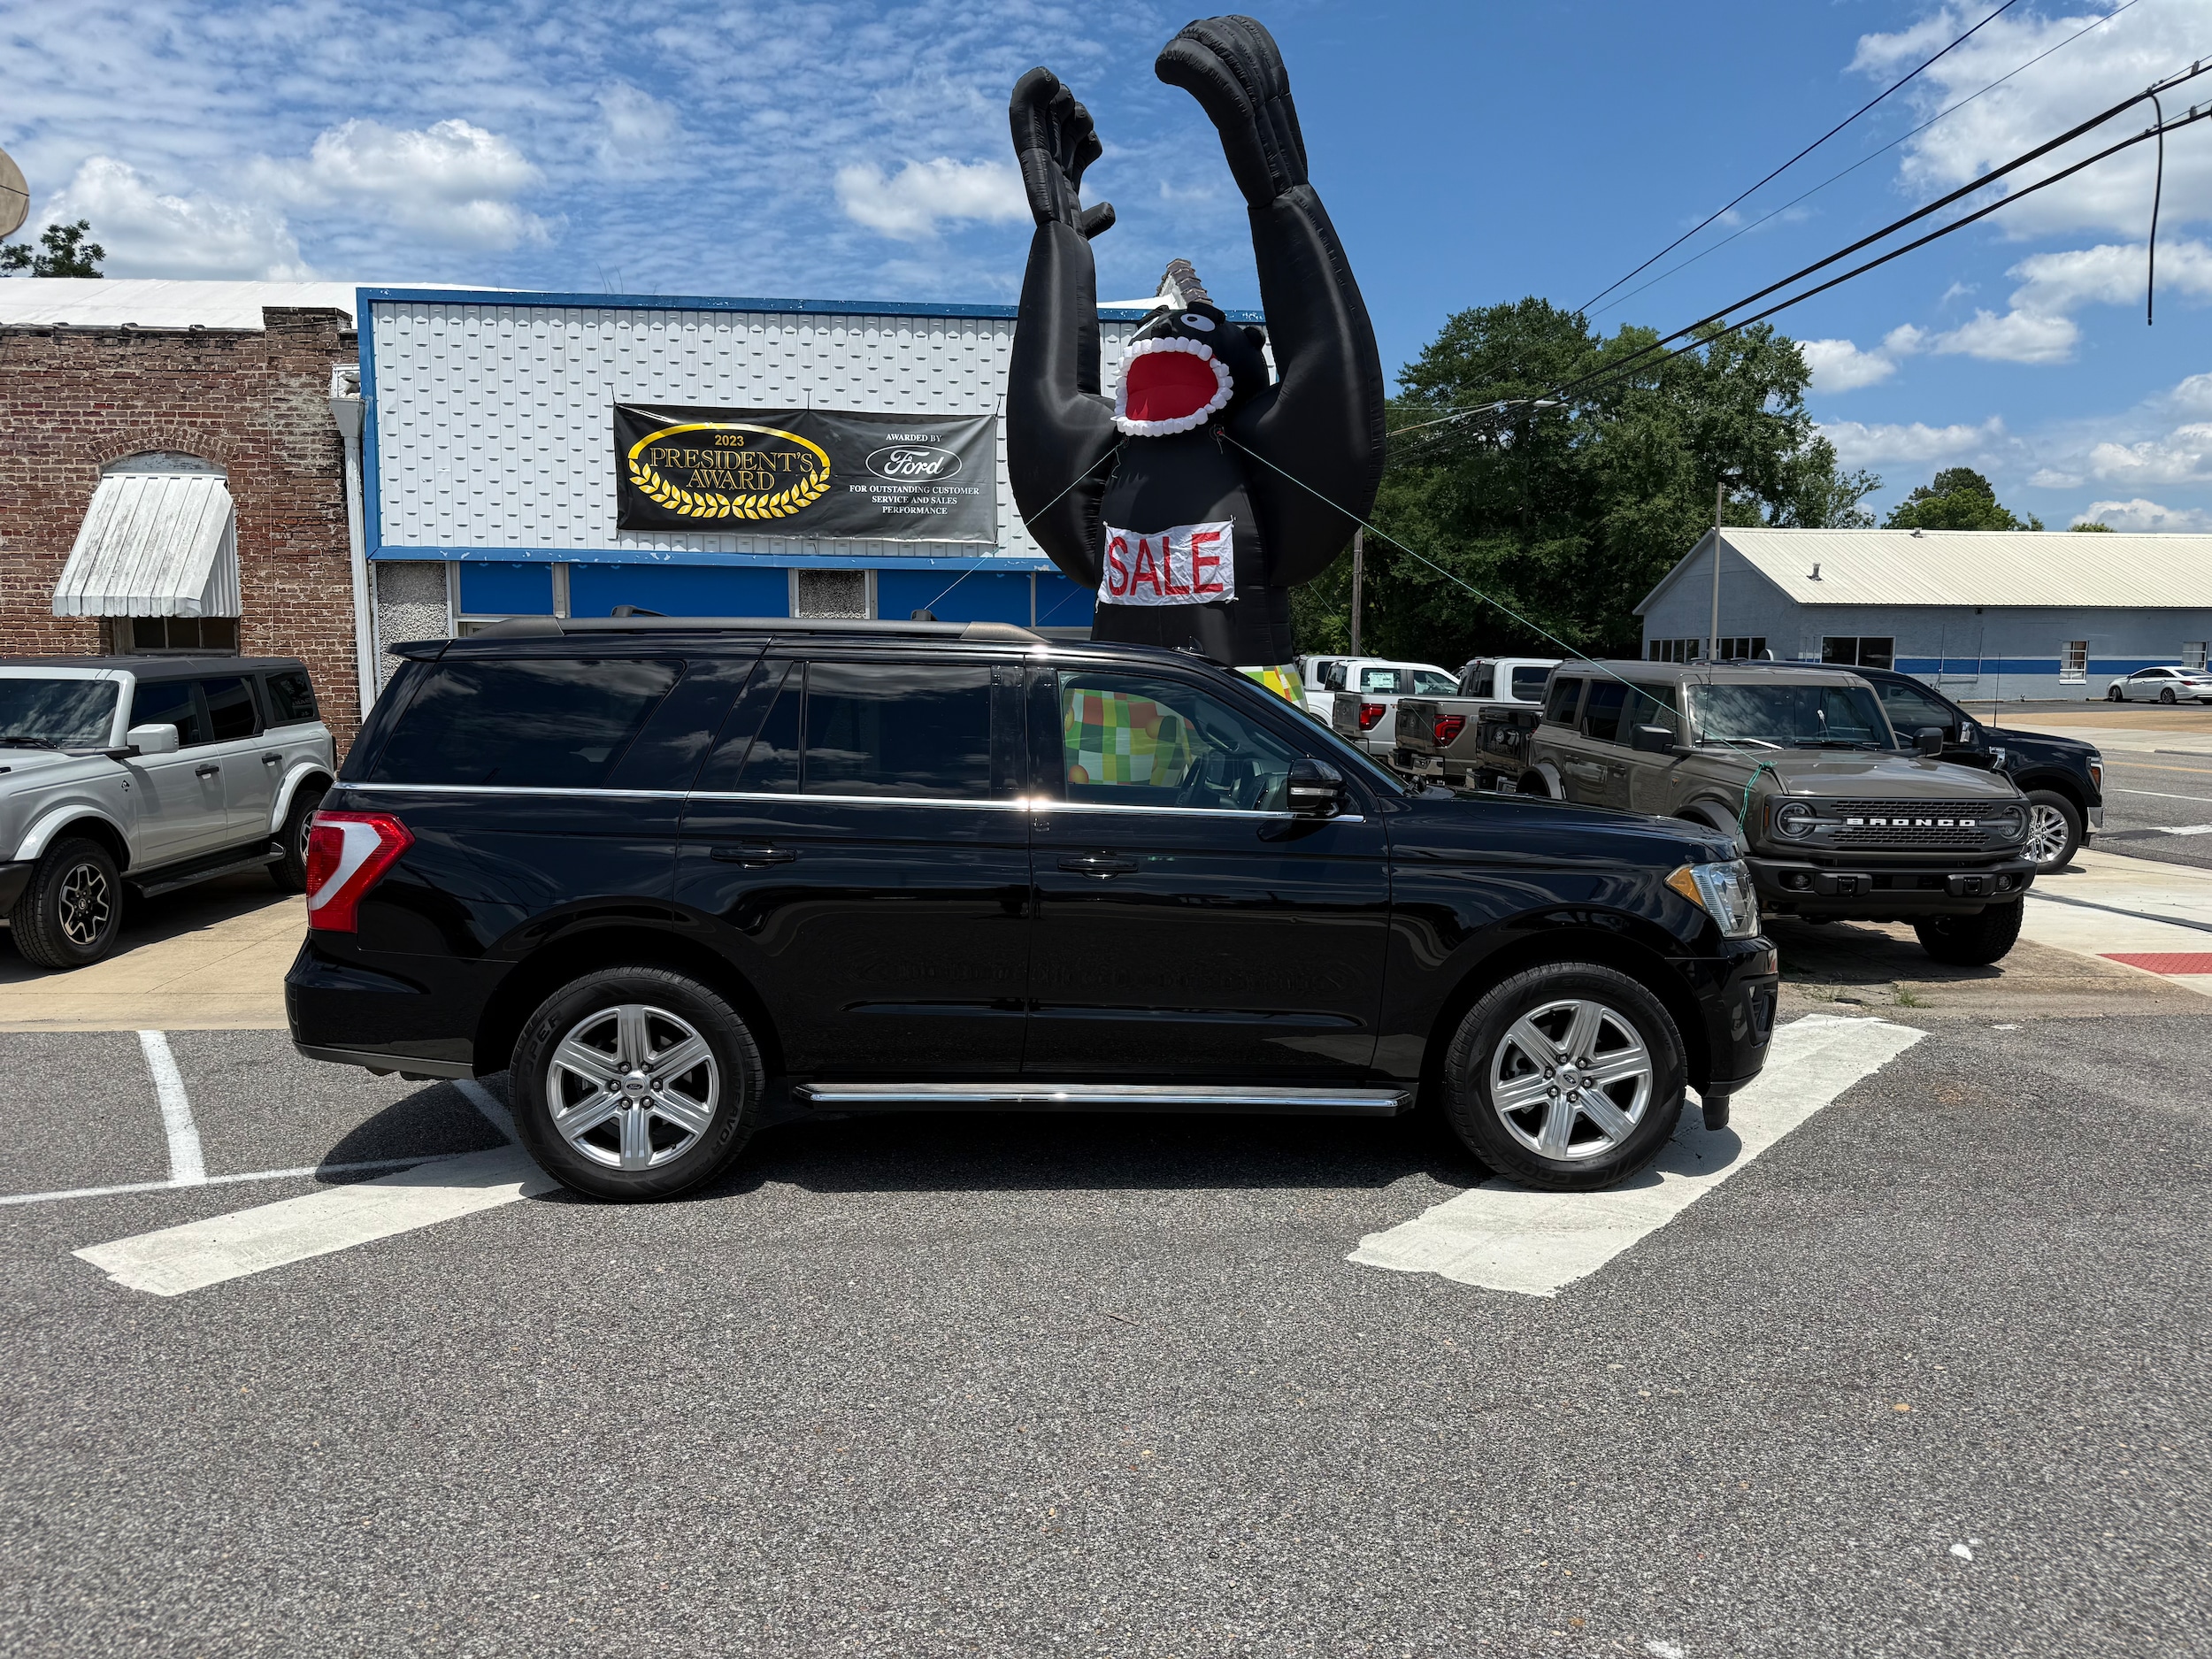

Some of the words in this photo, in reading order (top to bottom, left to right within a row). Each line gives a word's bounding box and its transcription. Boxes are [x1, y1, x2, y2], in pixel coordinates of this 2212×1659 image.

[714, 434, 745, 447] 2023
[649, 447, 814, 473] PRESIDENT'S
[884, 449, 945, 475] Ford
[685, 469, 775, 491] AWARD
[869, 485, 930, 494] OUTSTANDING
[882, 506, 949, 515] PERFORMANCE
[1108, 531, 1224, 596] SALE
[1846, 818, 1976, 826] BRONCO
